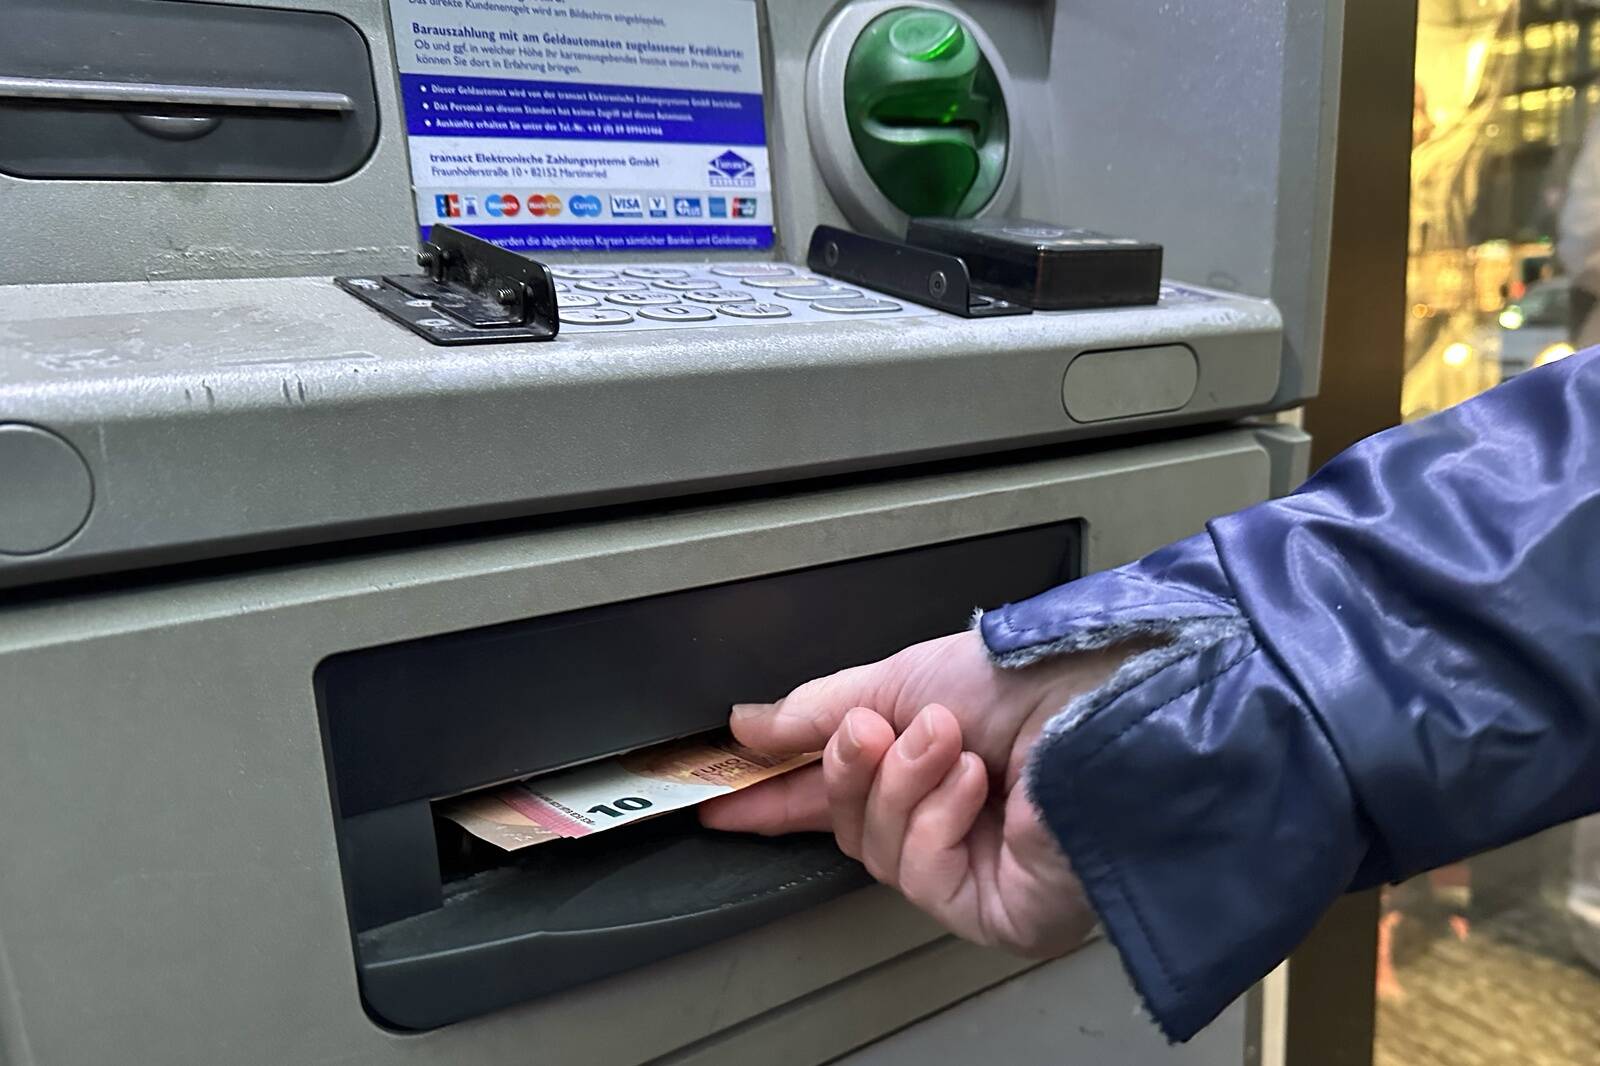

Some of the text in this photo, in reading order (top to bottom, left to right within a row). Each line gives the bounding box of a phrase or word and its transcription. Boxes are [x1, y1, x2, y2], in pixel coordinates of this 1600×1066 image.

[466, 0, 530, 15] Kundenentgelt
[532, 6, 551, 16] wird
[554, 9, 567, 17] am
[569, 8, 613, 21] Bildschirm
[412, 22, 495, 42] Barauszahlung
[499, 29, 519, 42] mit
[522, 31, 540, 43] am
[543, 32, 622, 49] Geldautomaten
[626, 40, 686, 55] zugelassener
[415, 39, 430, 50] Ob
[432, 40, 451, 52] und
[452, 42, 468, 54] ggf.
[469, 43, 478, 53] in
[480, 43, 516, 56] welcher
[519, 46, 543, 58] Höhe
[545, 48, 558, 58] Ihr
[560, 49, 637, 65] kartenausgebendes
[416, 54, 582, 75] können Sie dort in Erfahrung bringen.
[431, 84, 456, 95] Dieser
[458, 85, 507, 97] Geldautomat
[508, 89, 526, 98] wird
[527, 91, 541, 99] von
[543, 90, 556, 99] der
[433, 101, 448, 111] Das
[450, 102, 483, 112] Personal
[485, 104, 495, 113] an
[496, 104, 523, 114] diesem
[524, 105, 556, 115] Standort
[557, 106, 571, 116] hat
[572, 107, 596, 117] keinen
[436, 118, 474, 129] Auskünfte
[476, 119, 508, 130] erhalten
[509, 121, 520, 131] Sie
[522, 122, 542, 131] unter
[544, 122, 557, 131] der
[430, 152, 660, 169] transact Elektronische Zahlungssysteme GmbH
[432, 166, 607, 179] Fraunhoferstraße 10 82152 Martinsried
[614, 197, 640, 209] VISA
[663, 306, 689, 315] 0
[690, 757, 741, 777] EURO
[587, 796, 653, 819] 10
